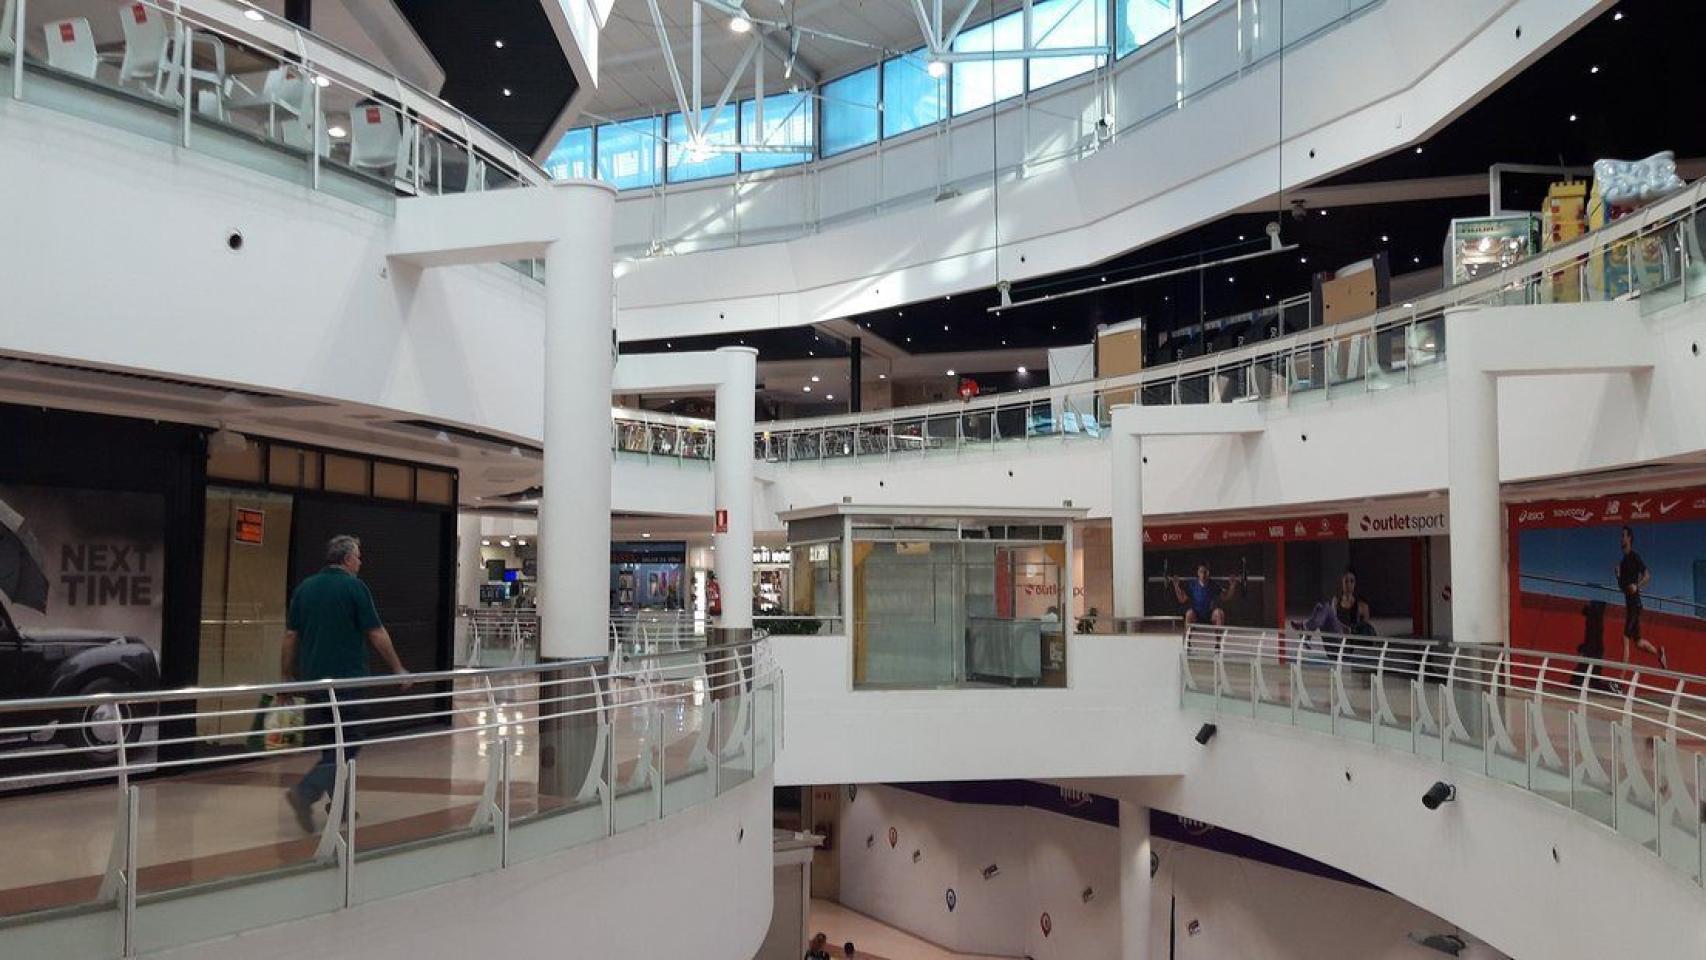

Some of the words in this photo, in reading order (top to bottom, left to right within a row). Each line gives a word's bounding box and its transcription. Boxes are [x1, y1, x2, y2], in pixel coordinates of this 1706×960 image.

[1373, 513, 1445, 533] outletsport
[61, 543, 153, 572] NEXT
[61, 575, 152, 606] TIME
